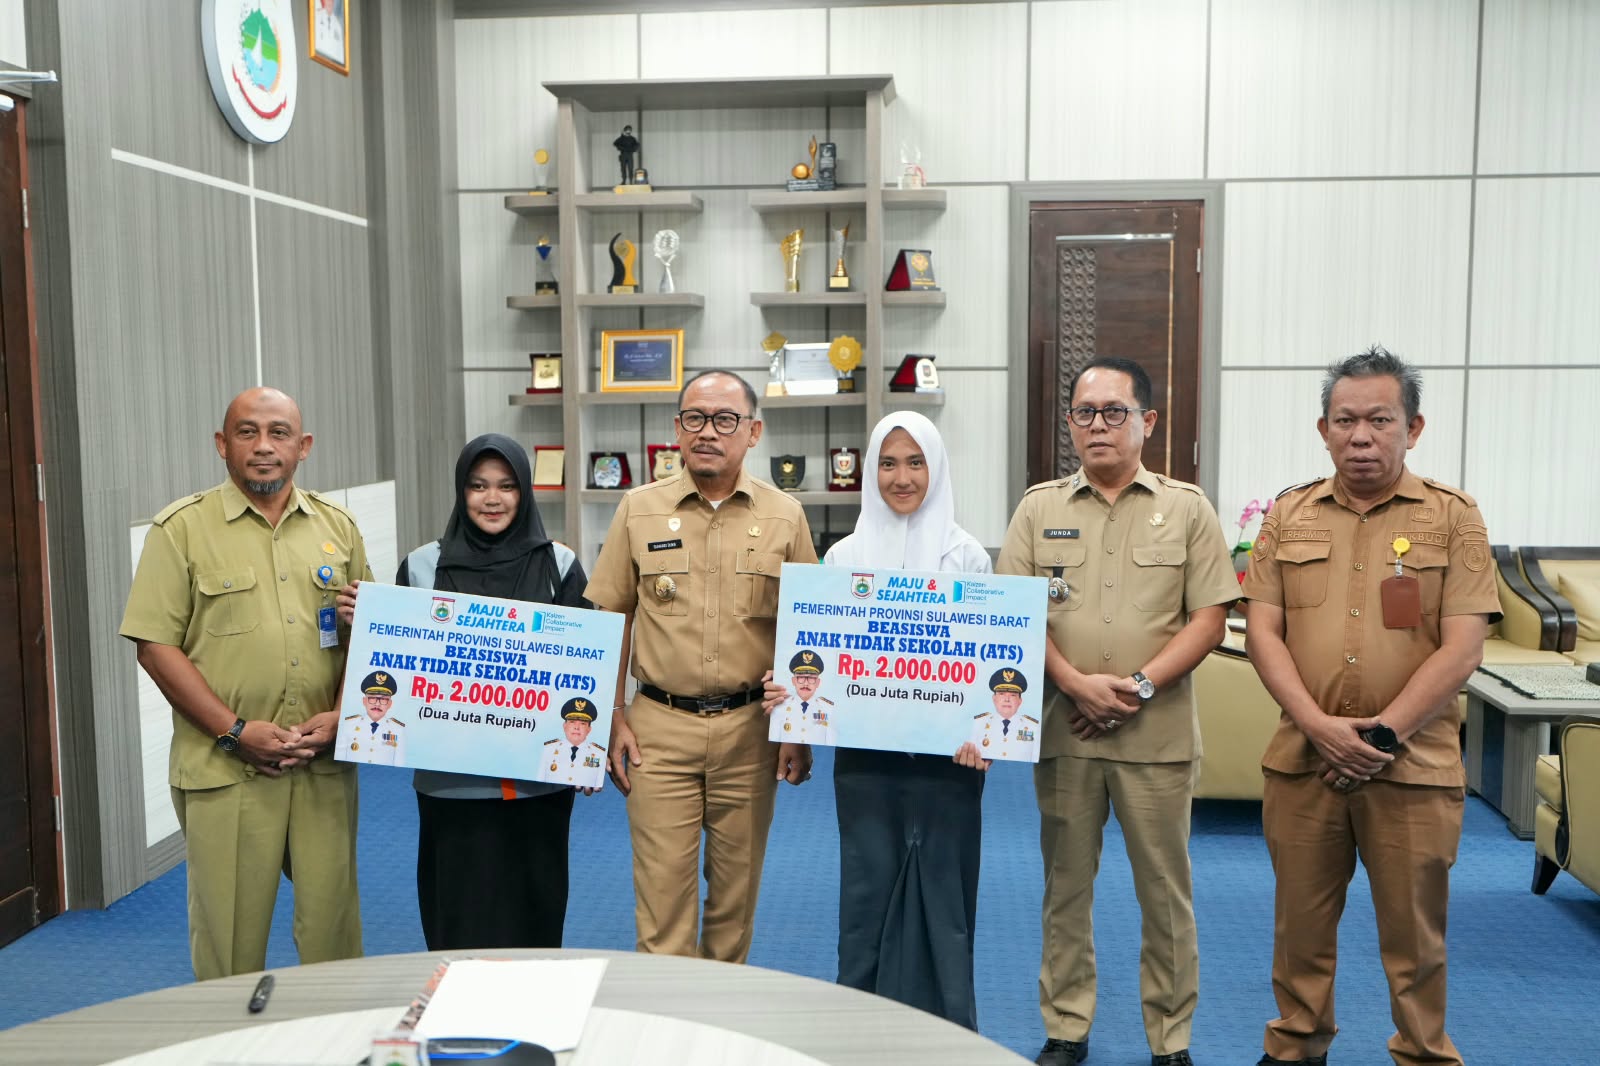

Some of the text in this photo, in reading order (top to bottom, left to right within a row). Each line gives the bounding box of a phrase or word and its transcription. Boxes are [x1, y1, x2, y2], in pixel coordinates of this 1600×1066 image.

[888, 576, 938, 591] MAJU &
[966, 587, 1005, 596] Collaborative
[876, 588, 947, 605] SEJAHTERA
[467, 602, 518, 619] MAJU &
[793, 602, 1030, 629] PEMERINTAH PROVINSI SULAWESI BARAT
[455, 614, 526, 633] SEJAHTERA
[545, 618, 583, 628] Collaborative
[867, 620, 951, 639] BEASISWA
[368, 622, 605, 661] PEMERINTAH PROVINSI SULAWESI BARAT
[795, 630, 1024, 665] ANAK TIDAK SEKOLAH (ATS)
[444, 644, 528, 667] BEASISWA
[369, 651, 597, 695] ANAK TIDAK SEKOLAH (ATS)
[837, 652, 977, 685] Rp. 2.000.000
[410, 674, 550, 712] Rp. 2.000.000
[846, 684, 965, 706] (Dua Juta Rupiah)
[418, 705, 537, 732] (Dua Juta Rupiah)
